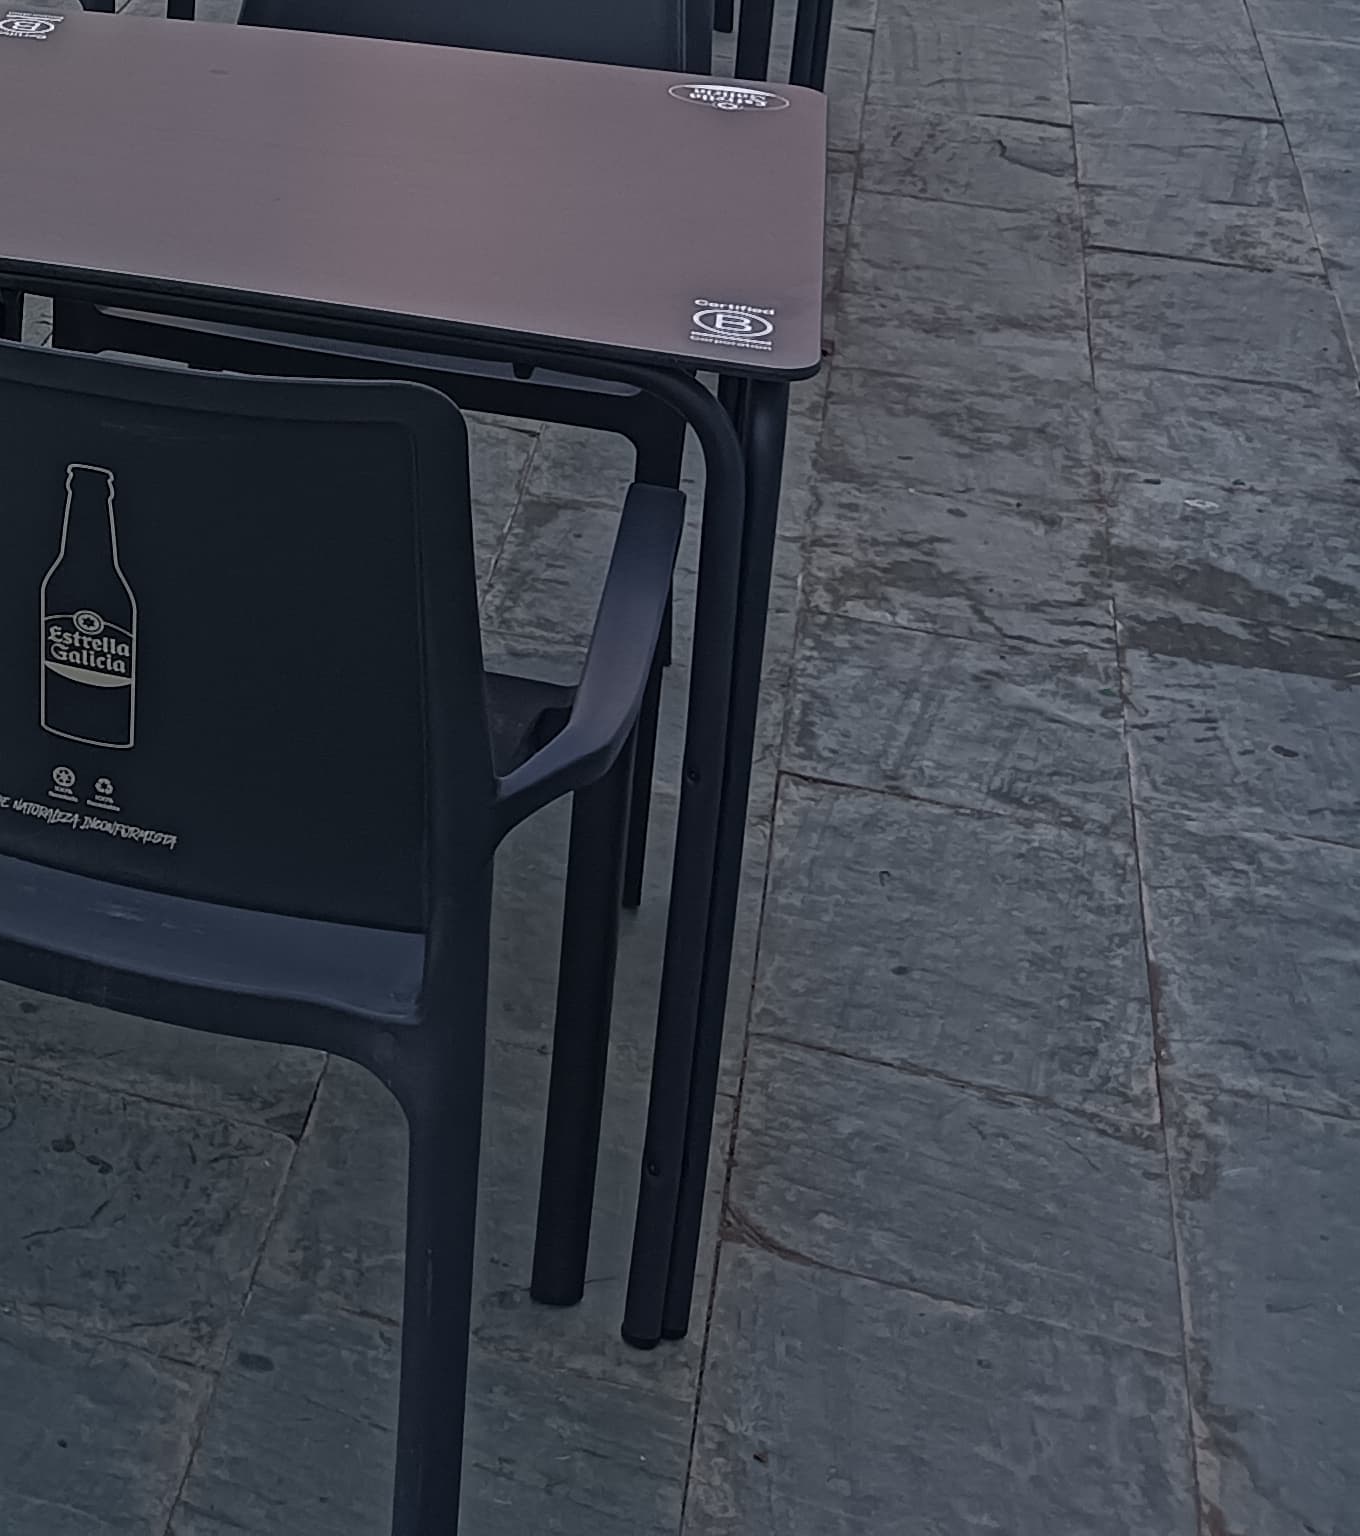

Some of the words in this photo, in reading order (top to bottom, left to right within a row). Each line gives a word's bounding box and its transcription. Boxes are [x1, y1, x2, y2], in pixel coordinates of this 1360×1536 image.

[694, 298, 776, 316] Certified
[715, 312, 752, 332] B
[47, 625, 132, 659] Estrella
[50, 643, 128, 675] Galicia
